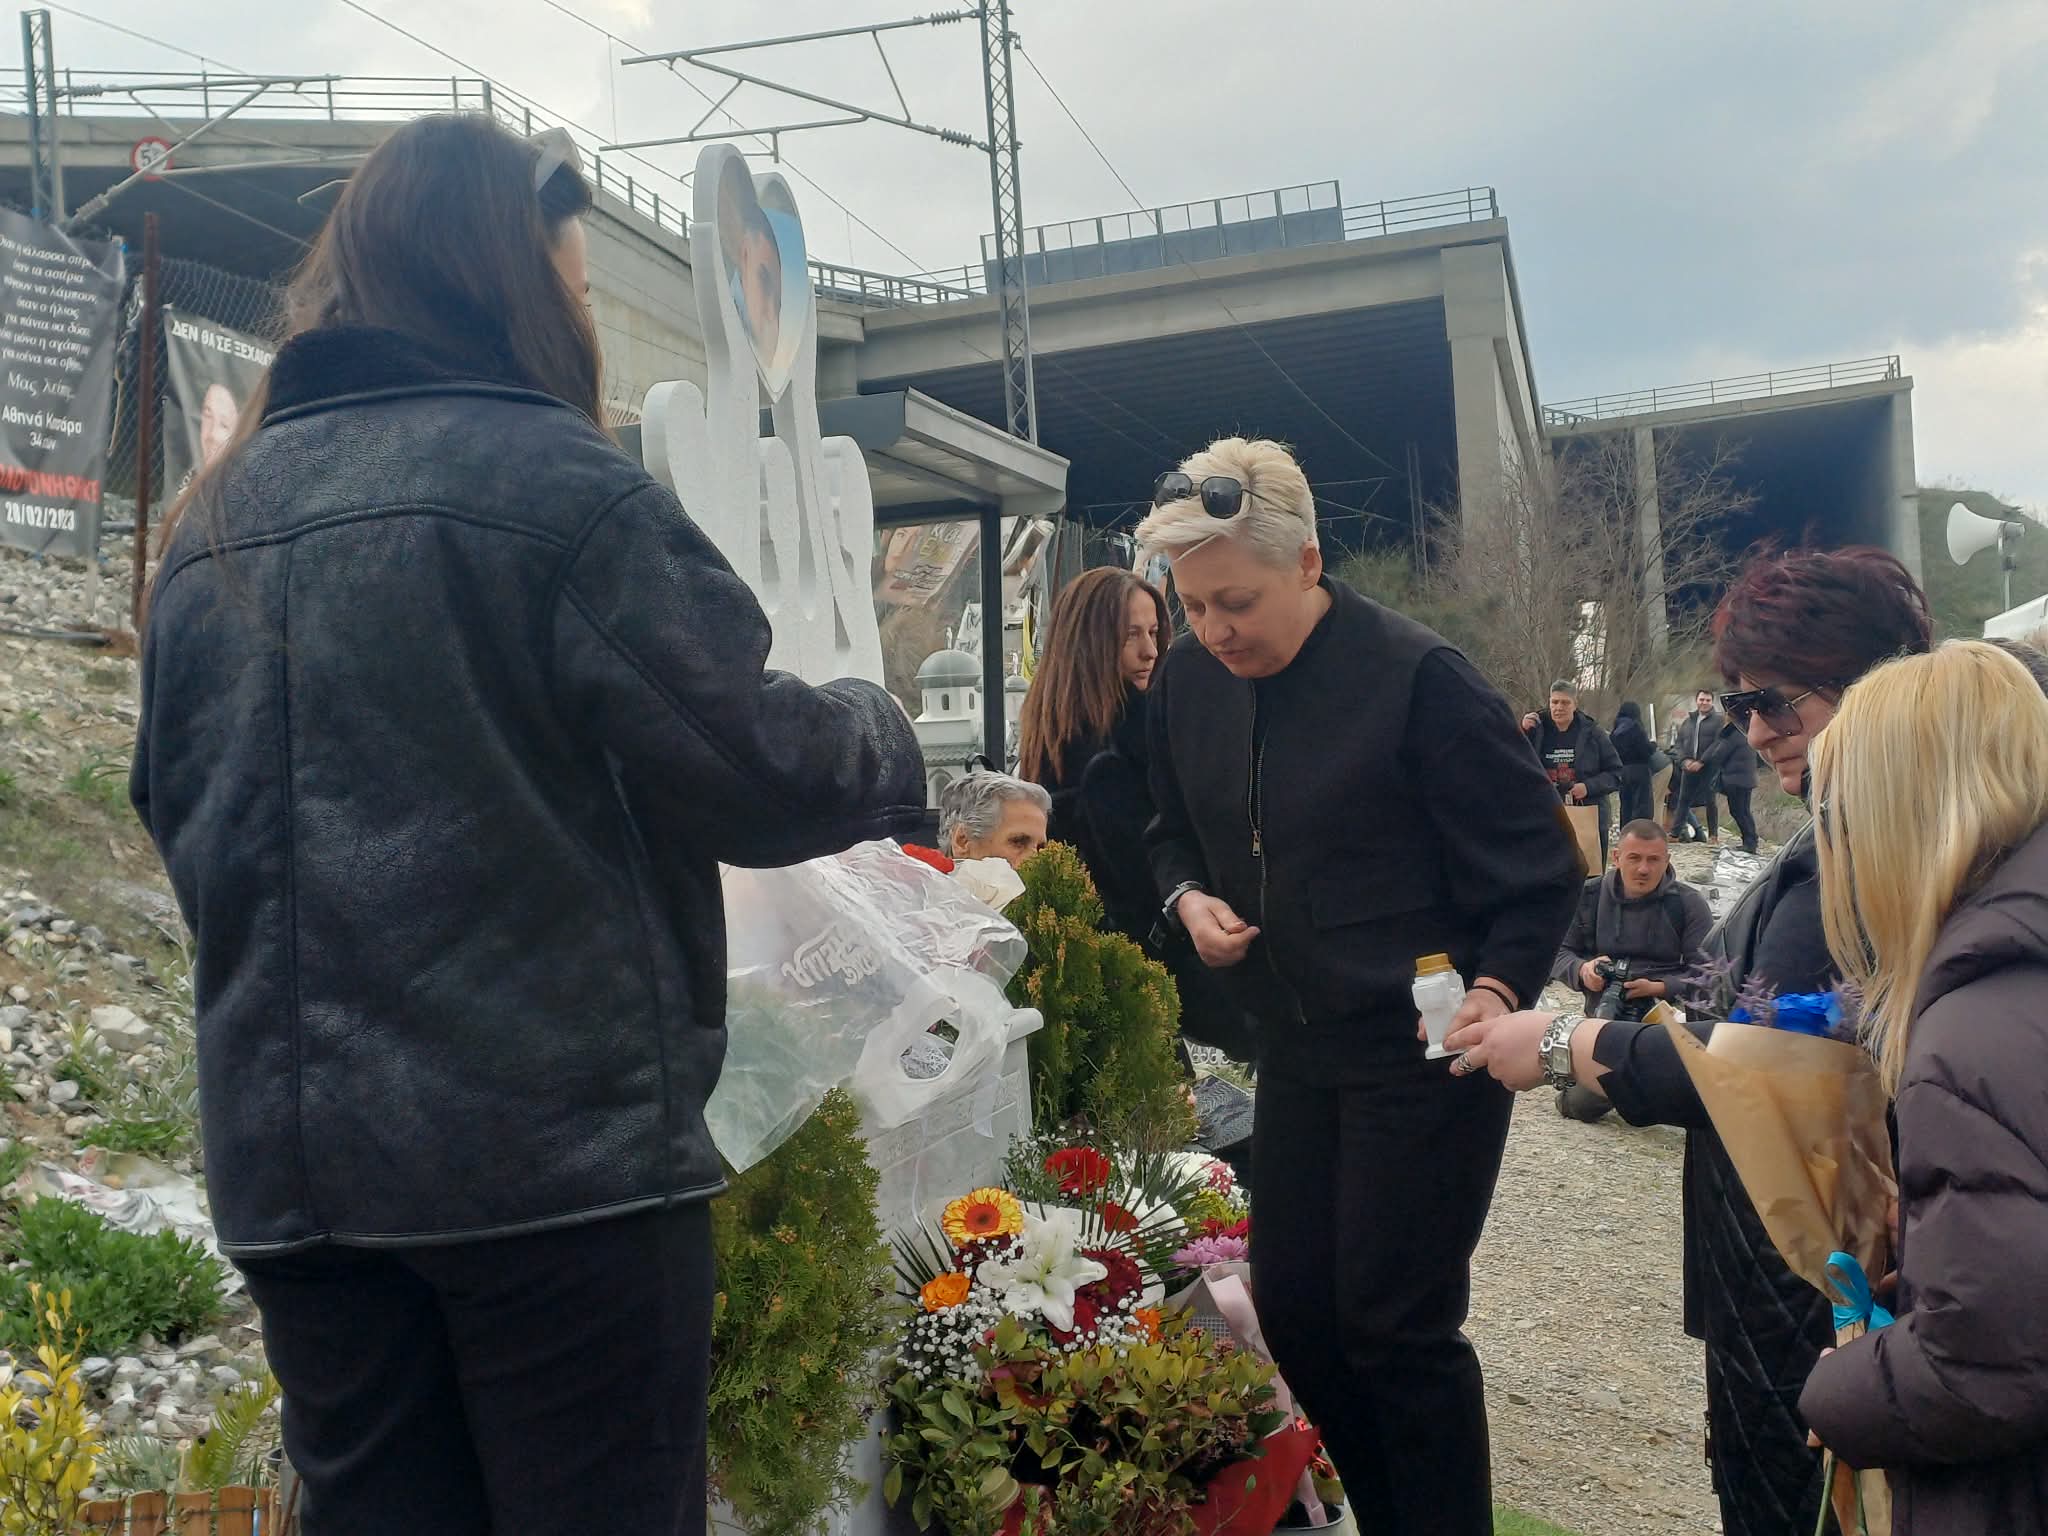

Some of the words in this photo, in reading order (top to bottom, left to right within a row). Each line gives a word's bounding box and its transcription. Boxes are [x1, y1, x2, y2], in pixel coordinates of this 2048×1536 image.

[171, 320, 199, 343] ΔΕΝ
[200, 328, 216, 349] ΘΑ
[7, 370, 38, 397] Μας
[2, 403, 43, 428] Αθηνά
